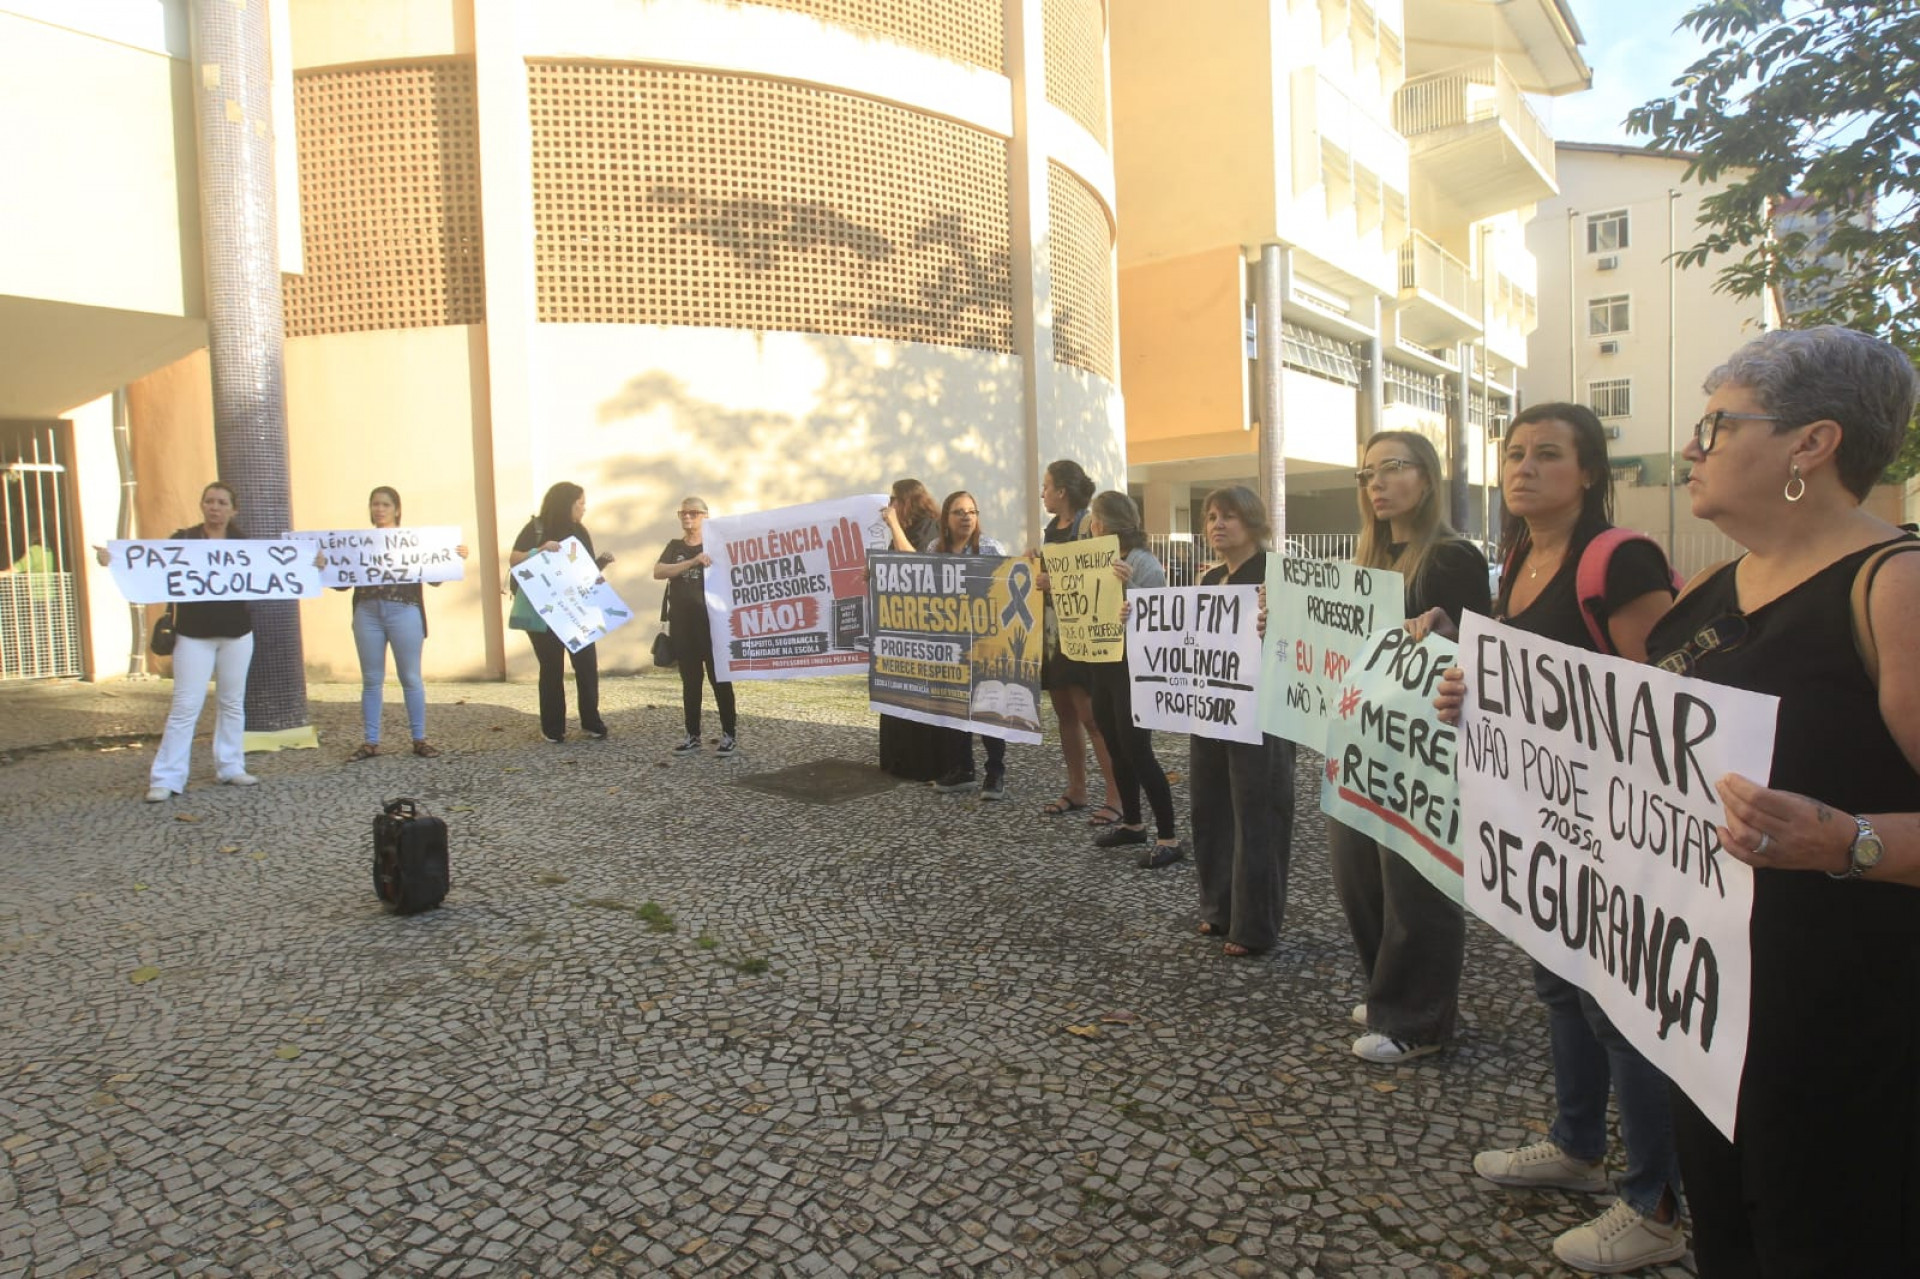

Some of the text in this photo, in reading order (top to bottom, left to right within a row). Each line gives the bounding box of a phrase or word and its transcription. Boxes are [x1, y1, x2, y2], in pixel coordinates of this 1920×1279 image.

[385, 530, 419, 549] NÃO
[726, 525, 824, 566] VIOLÊNCIA
[126, 544, 251, 569] PAZ NAS
[401, 548, 451, 566] LUGAR
[730, 555, 807, 588] CONTRA
[1047, 550, 1115, 573] NDO MELHOR
[166, 570, 304, 597] ESCOLAS
[338, 567, 423, 583] DE PAZ!
[732, 574, 831, 606] PROFESSORES,
[875, 563, 967, 594] BASTA DE
[1282, 558, 1373, 596] RESPEITO AO
[740, 601, 806, 636] NÃO!
[878, 594, 998, 636] AGRESSÃO!
[1136, 594, 1240, 634] PELO FIM
[1307, 595, 1375, 641] PROFESSOR!
[881, 639, 953, 662] PROFESSOR
[1184, 631, 1195, 645] da
[881, 659, 962, 681] MERECE RESPEITO
[1365, 628, 1457, 698] PROF
[1169, 676, 1188, 687] com
[1287, 682, 1311, 713] NÃO
[1477, 634, 1717, 805] ENSINAR
[1361, 700, 1458, 783] MERE
[1465, 716, 1725, 898] NÃO PODE CUSTAR
[1538, 807, 1604, 864] nossa
[1478, 820, 1720, 1053] SEGURANÇA
